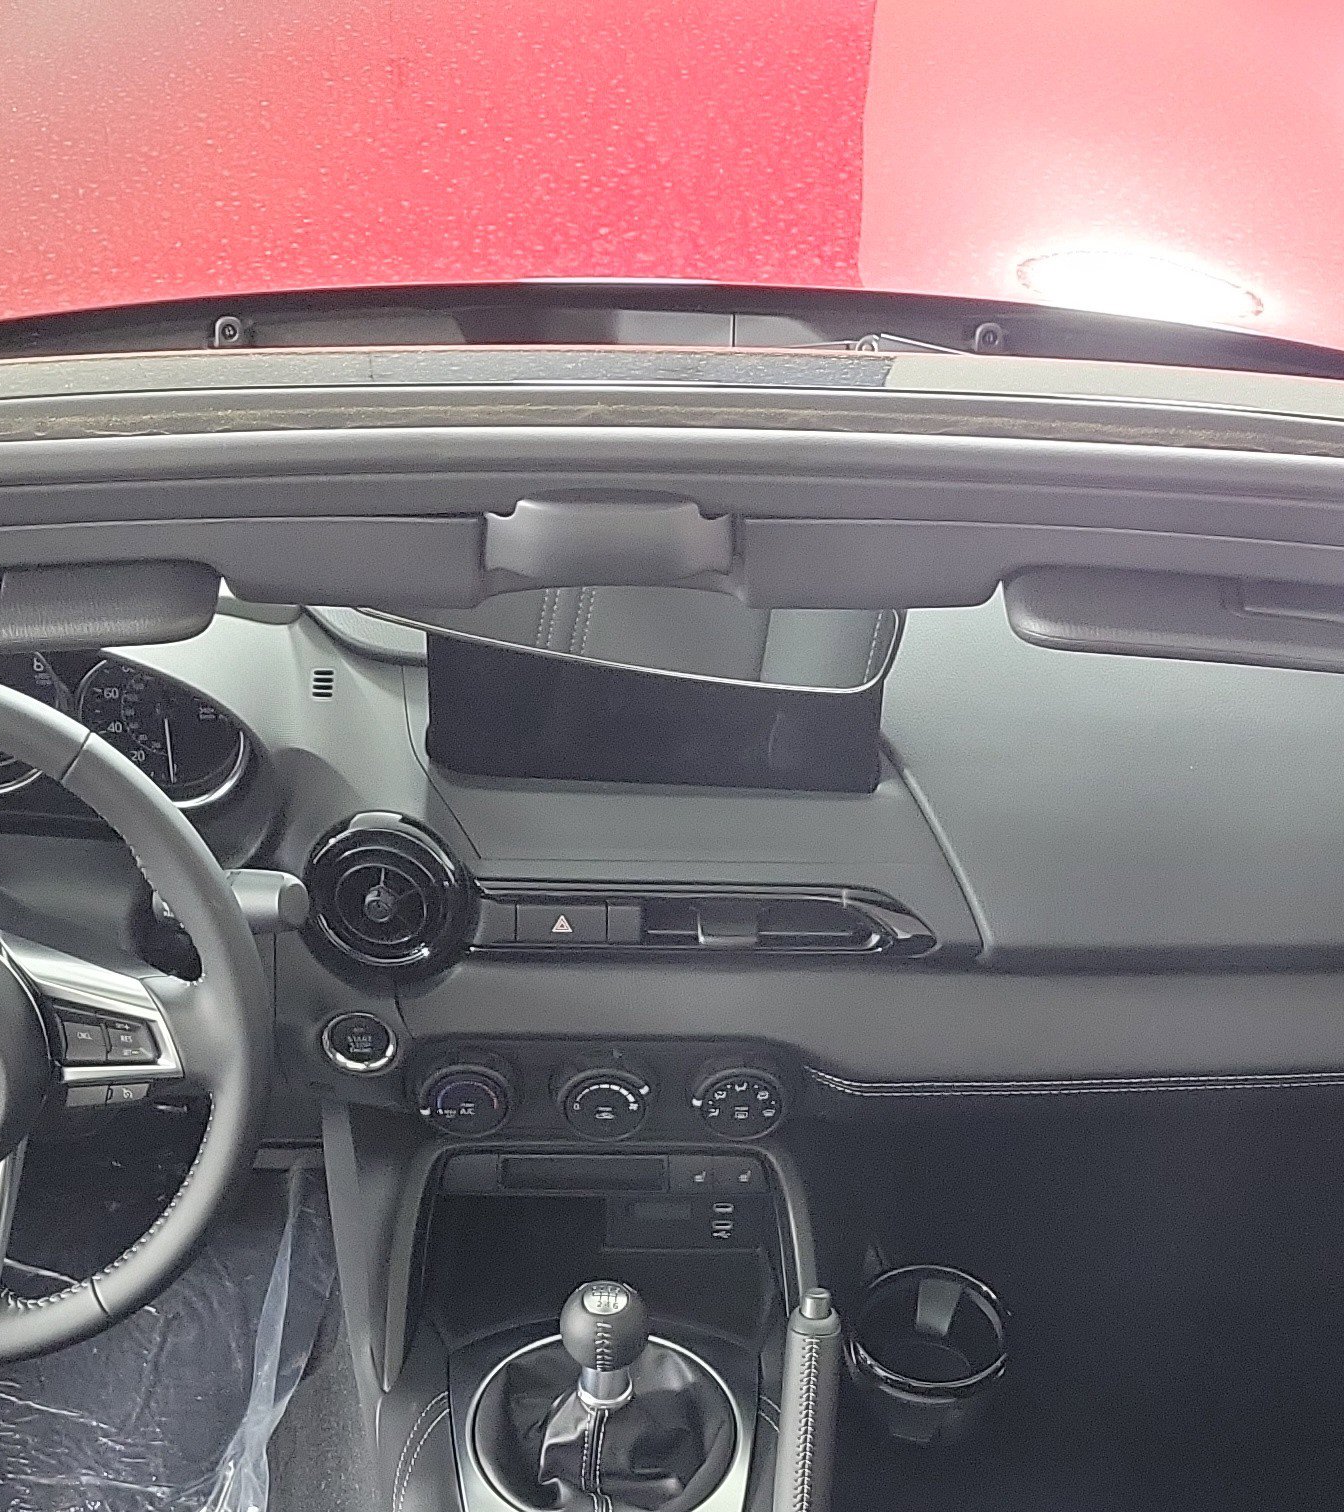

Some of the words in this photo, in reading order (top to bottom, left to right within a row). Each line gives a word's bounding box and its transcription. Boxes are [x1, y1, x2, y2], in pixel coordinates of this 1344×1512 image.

[103, 687, 120, 699] 60
[107, 722, 123, 733] 40
[131, 750, 146, 762] 20
